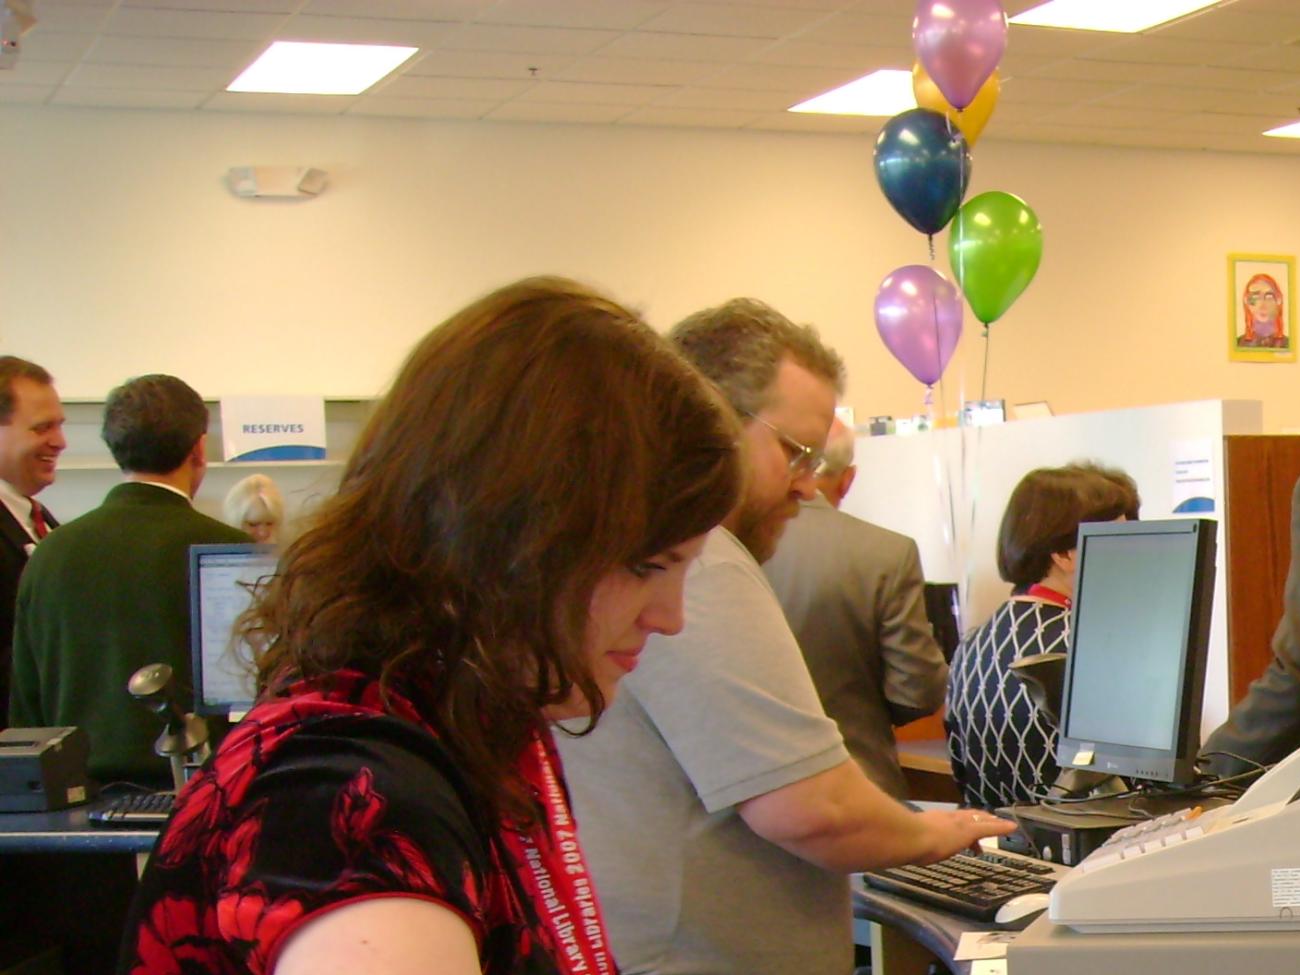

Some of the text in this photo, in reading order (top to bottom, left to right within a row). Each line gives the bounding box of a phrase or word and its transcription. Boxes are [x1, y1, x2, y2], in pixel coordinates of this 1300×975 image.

[242, 423, 304, 434] RESERVES
[556, 829, 585, 875] 2007
[524, 847, 566, 913] National
[552, 912, 588, 972] Library
